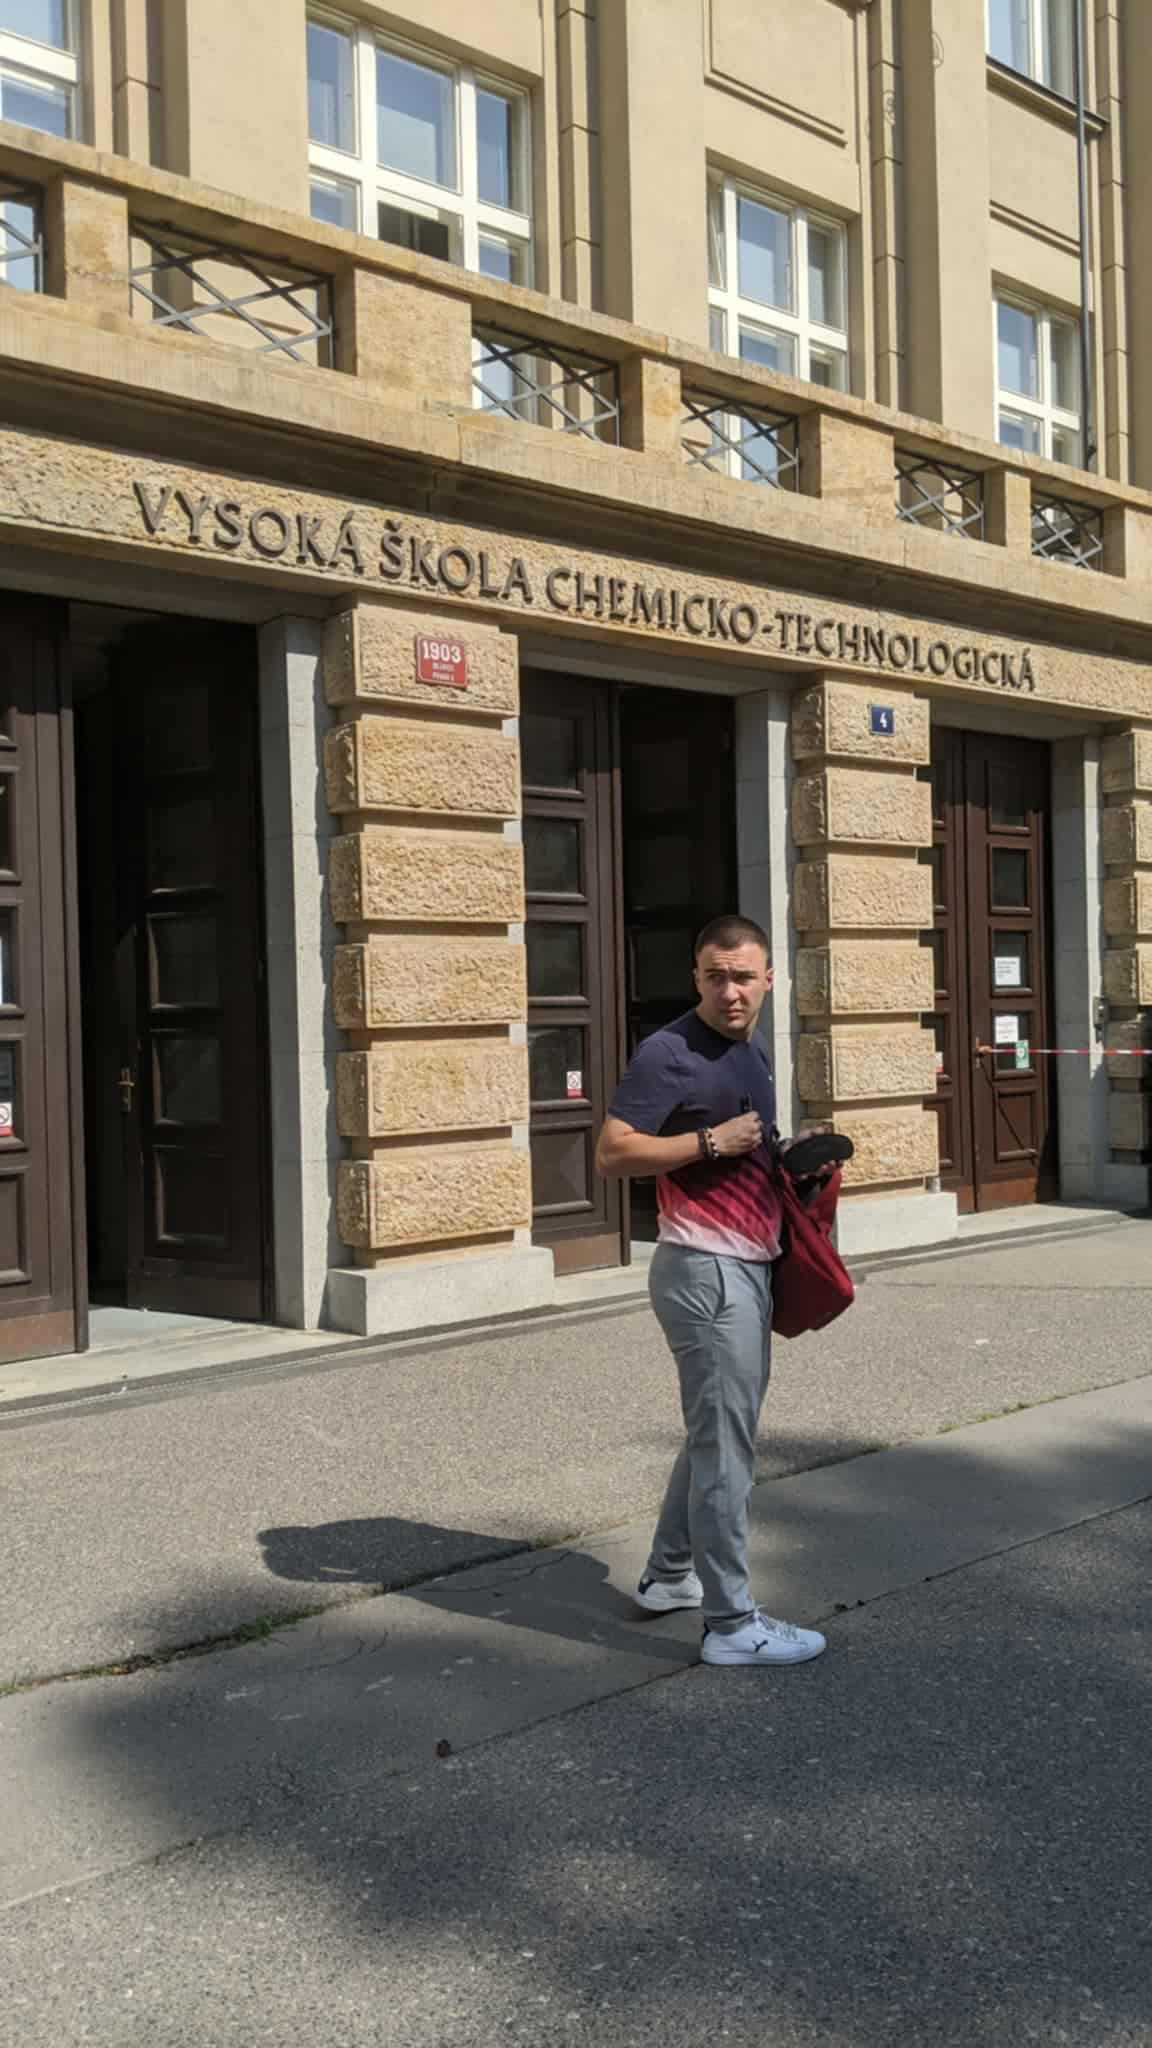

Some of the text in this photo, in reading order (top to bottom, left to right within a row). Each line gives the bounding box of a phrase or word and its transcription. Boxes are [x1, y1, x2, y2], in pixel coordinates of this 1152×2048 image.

[132, 481, 1037, 693] VYSOKÁ ŠKOLA CHEMICKO-TECHNOLOGICKÁ
[423, 640, 462, 664] 1903
[879, 711, 888, 729] 4
